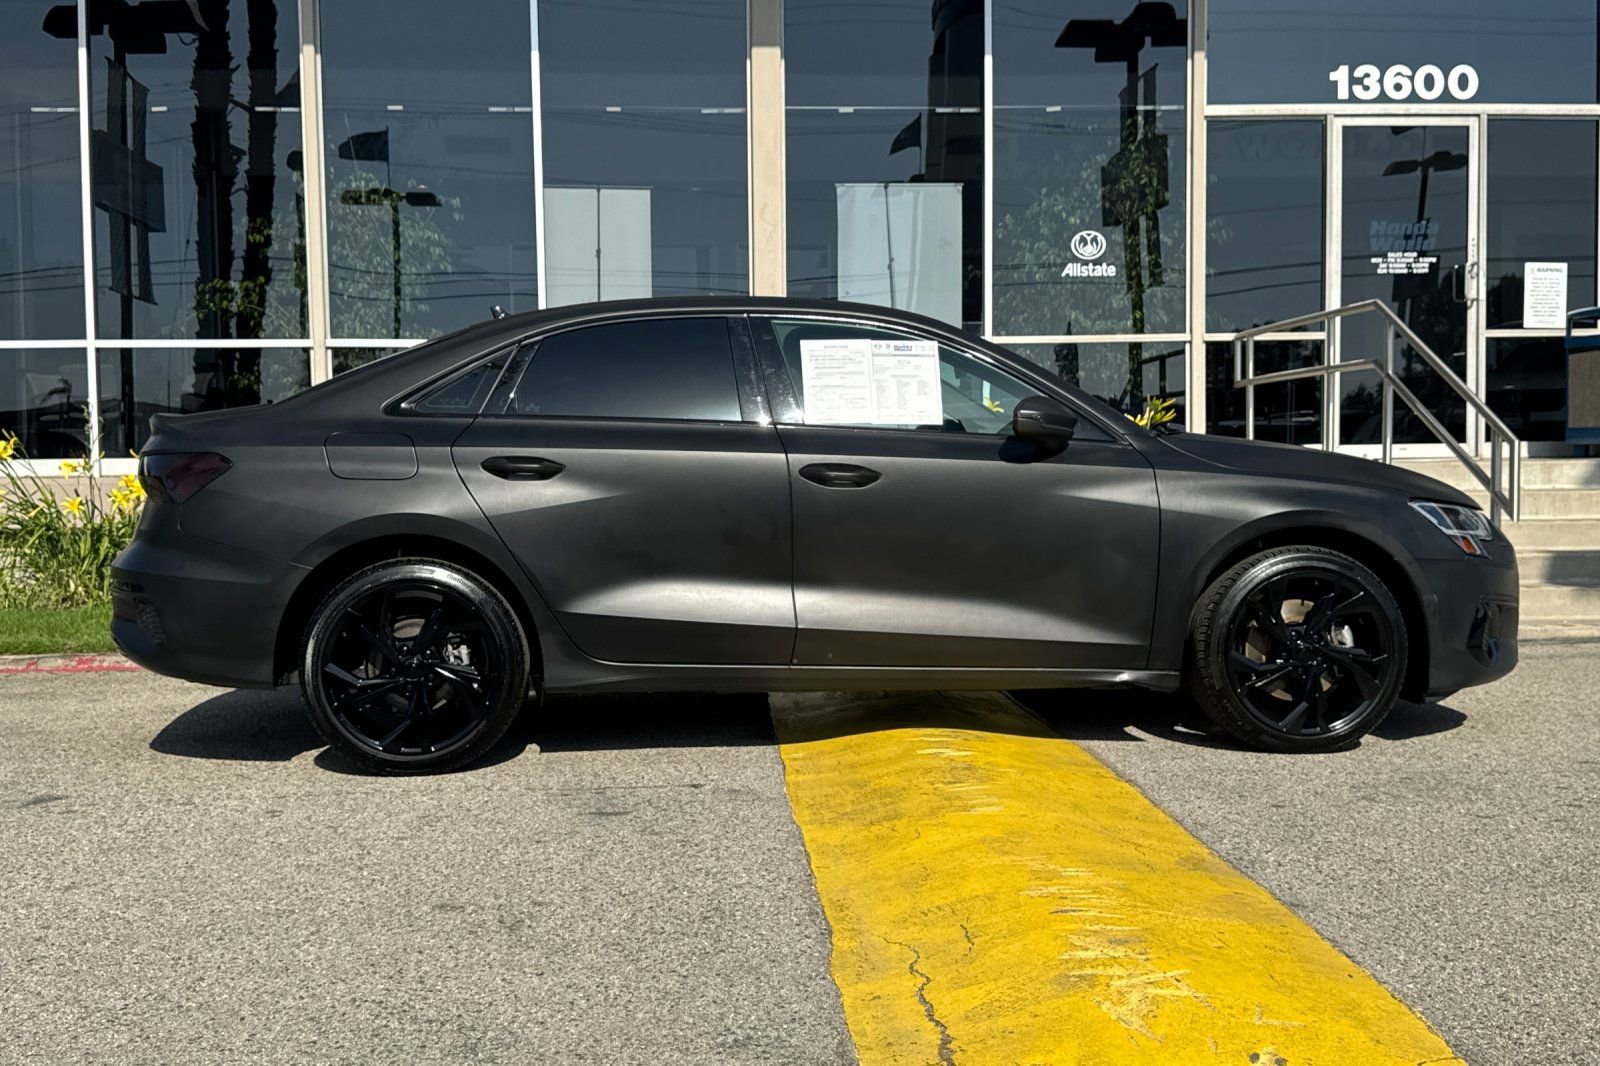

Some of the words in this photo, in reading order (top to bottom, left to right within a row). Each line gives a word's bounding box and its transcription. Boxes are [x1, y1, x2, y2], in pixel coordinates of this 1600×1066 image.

[1329, 64, 1479, 100] 13600
[1370, 219, 1439, 235] Honda
[1370, 236, 1437, 252] World
[1061, 262, 1117, 277] Allstate
